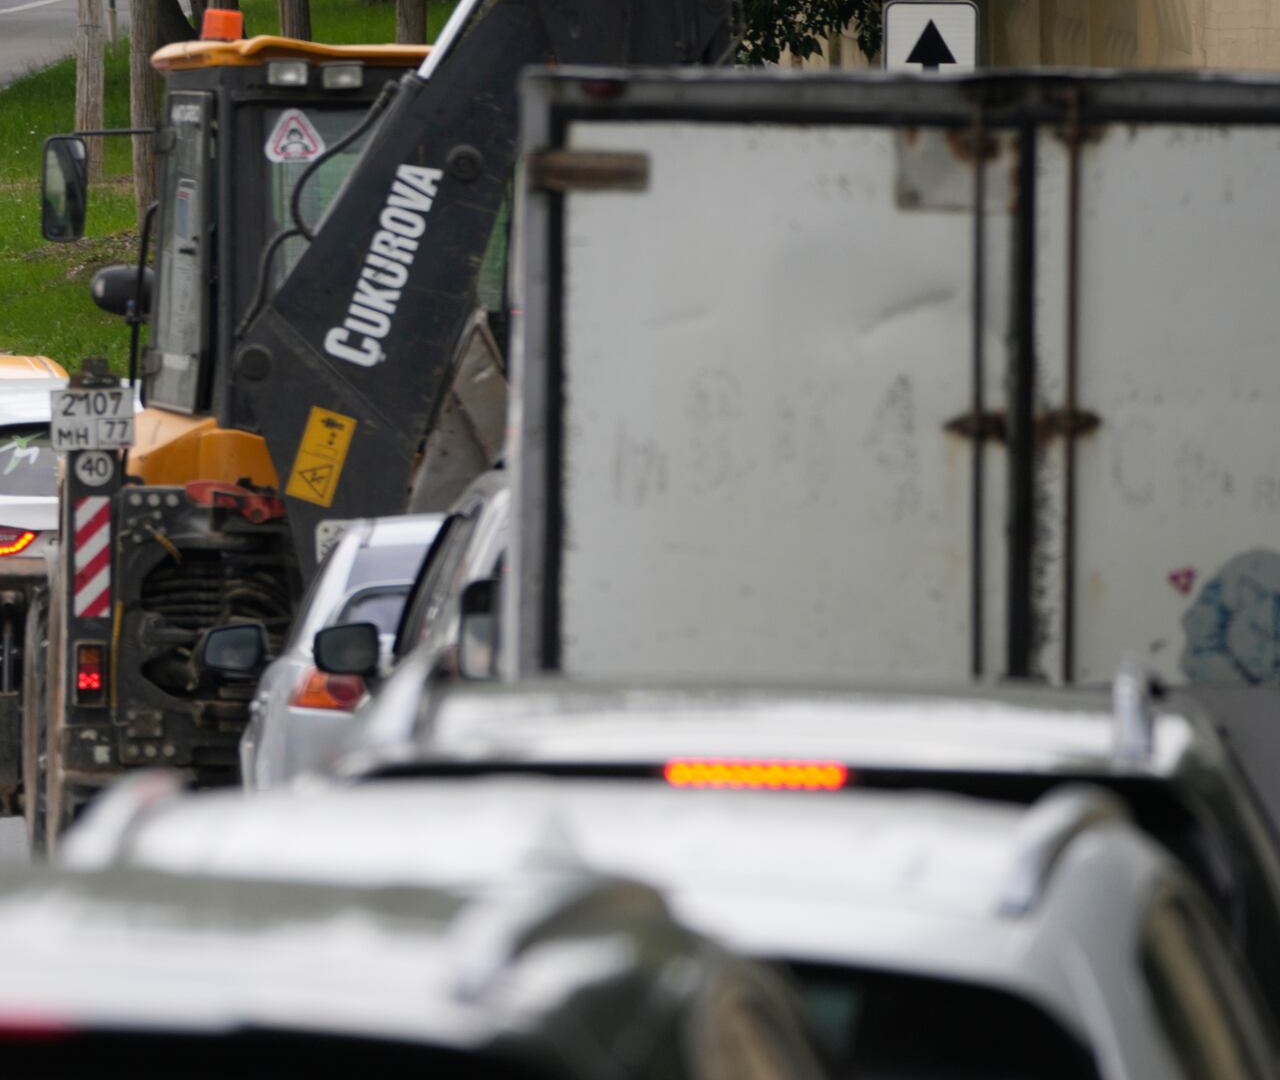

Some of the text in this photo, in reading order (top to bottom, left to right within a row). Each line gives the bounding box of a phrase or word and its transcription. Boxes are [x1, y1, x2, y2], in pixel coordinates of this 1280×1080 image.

[62, 392, 122, 416] 2107
[58, 427, 88, 445] МН
[105, 421, 128, 439] 77
[82, 457, 108, 477] 40
